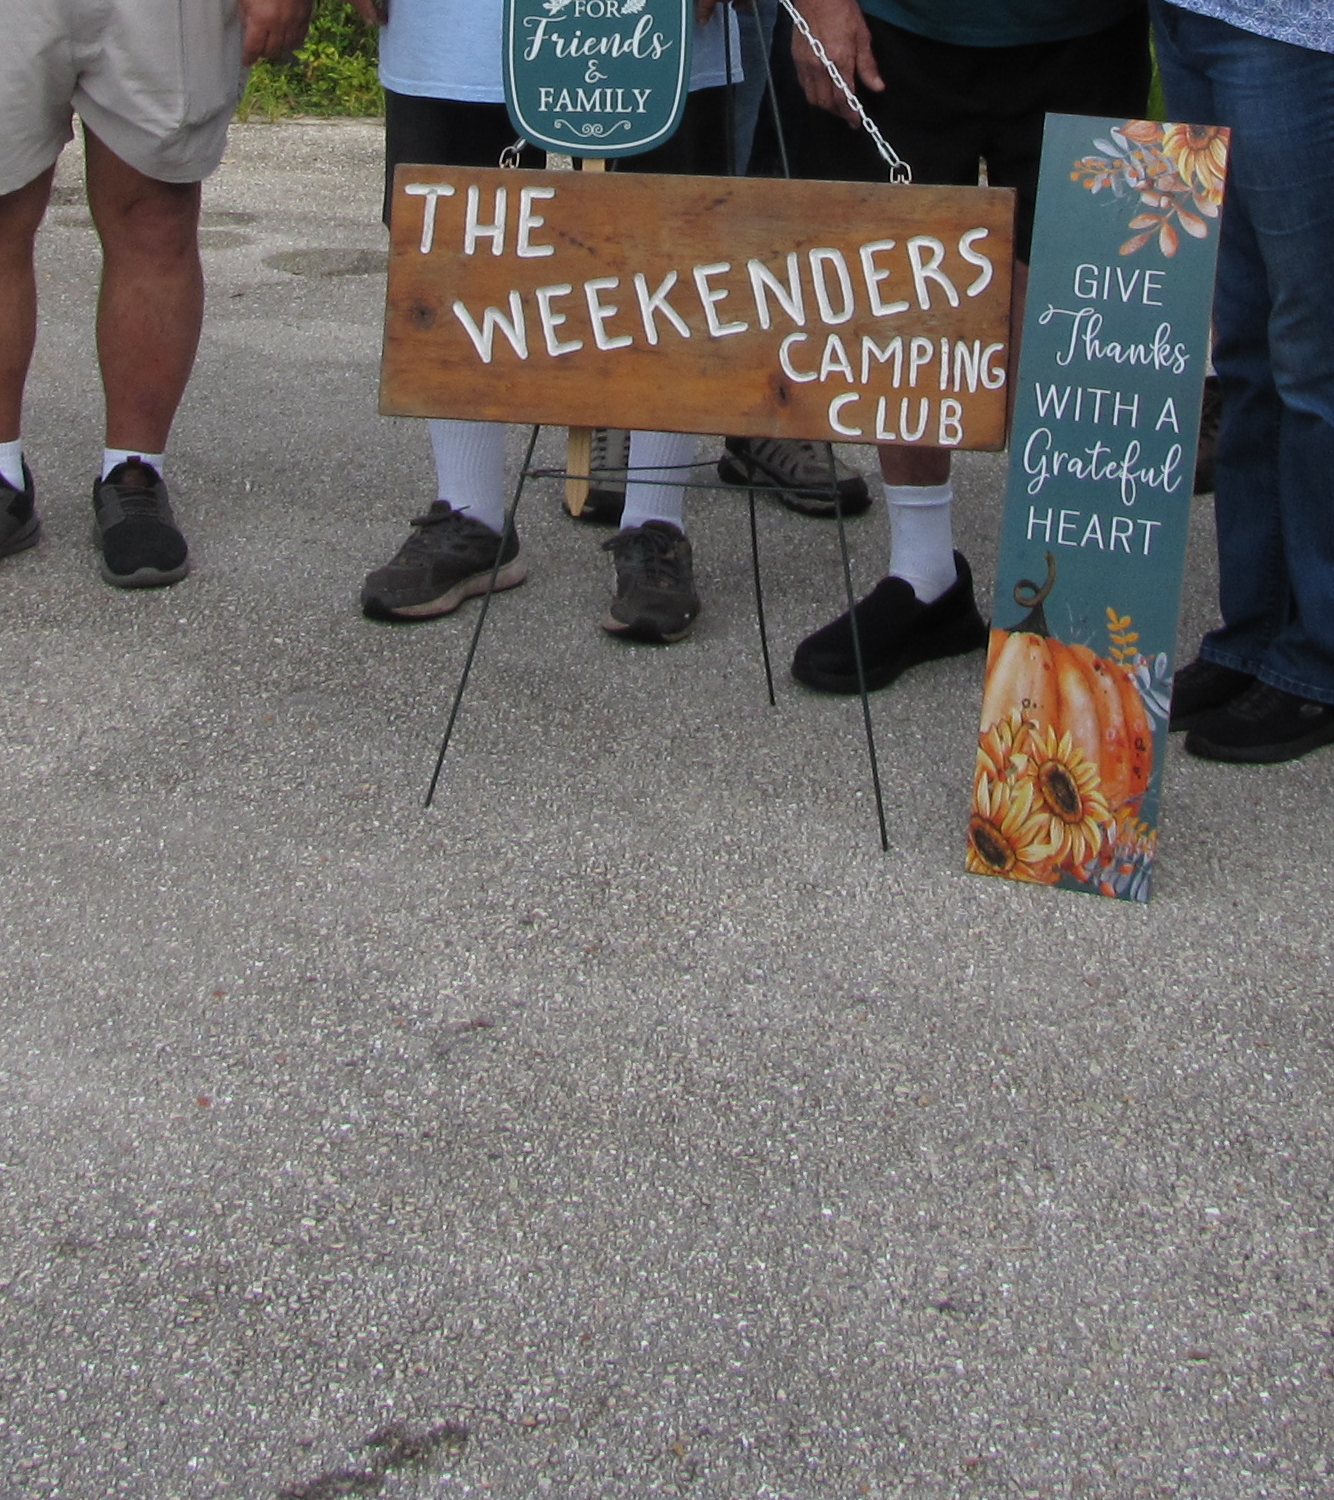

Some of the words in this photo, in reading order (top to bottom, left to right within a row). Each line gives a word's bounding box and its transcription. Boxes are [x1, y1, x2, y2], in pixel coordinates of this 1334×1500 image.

[574, 0, 621, 18] FOR
[523, 14, 673, 61] Friends
[584, 59, 608, 83] &
[538, 87, 652, 113] FAMILY
[404, 182, 557, 258] THE
[453, 227, 995, 364] WEEKENDERS
[1073, 263, 1166, 306] GIVE
[779, 332, 1005, 393] CAMPING
[1038, 303, 1190, 374] Thanks
[827, 392, 965, 446] CLUB
[1035, 383, 1138, 428] WITH
[1156, 397, 1179, 433] A
[1023, 427, 1182, 506] Grateful
[1027, 505, 1161, 555] HEART
